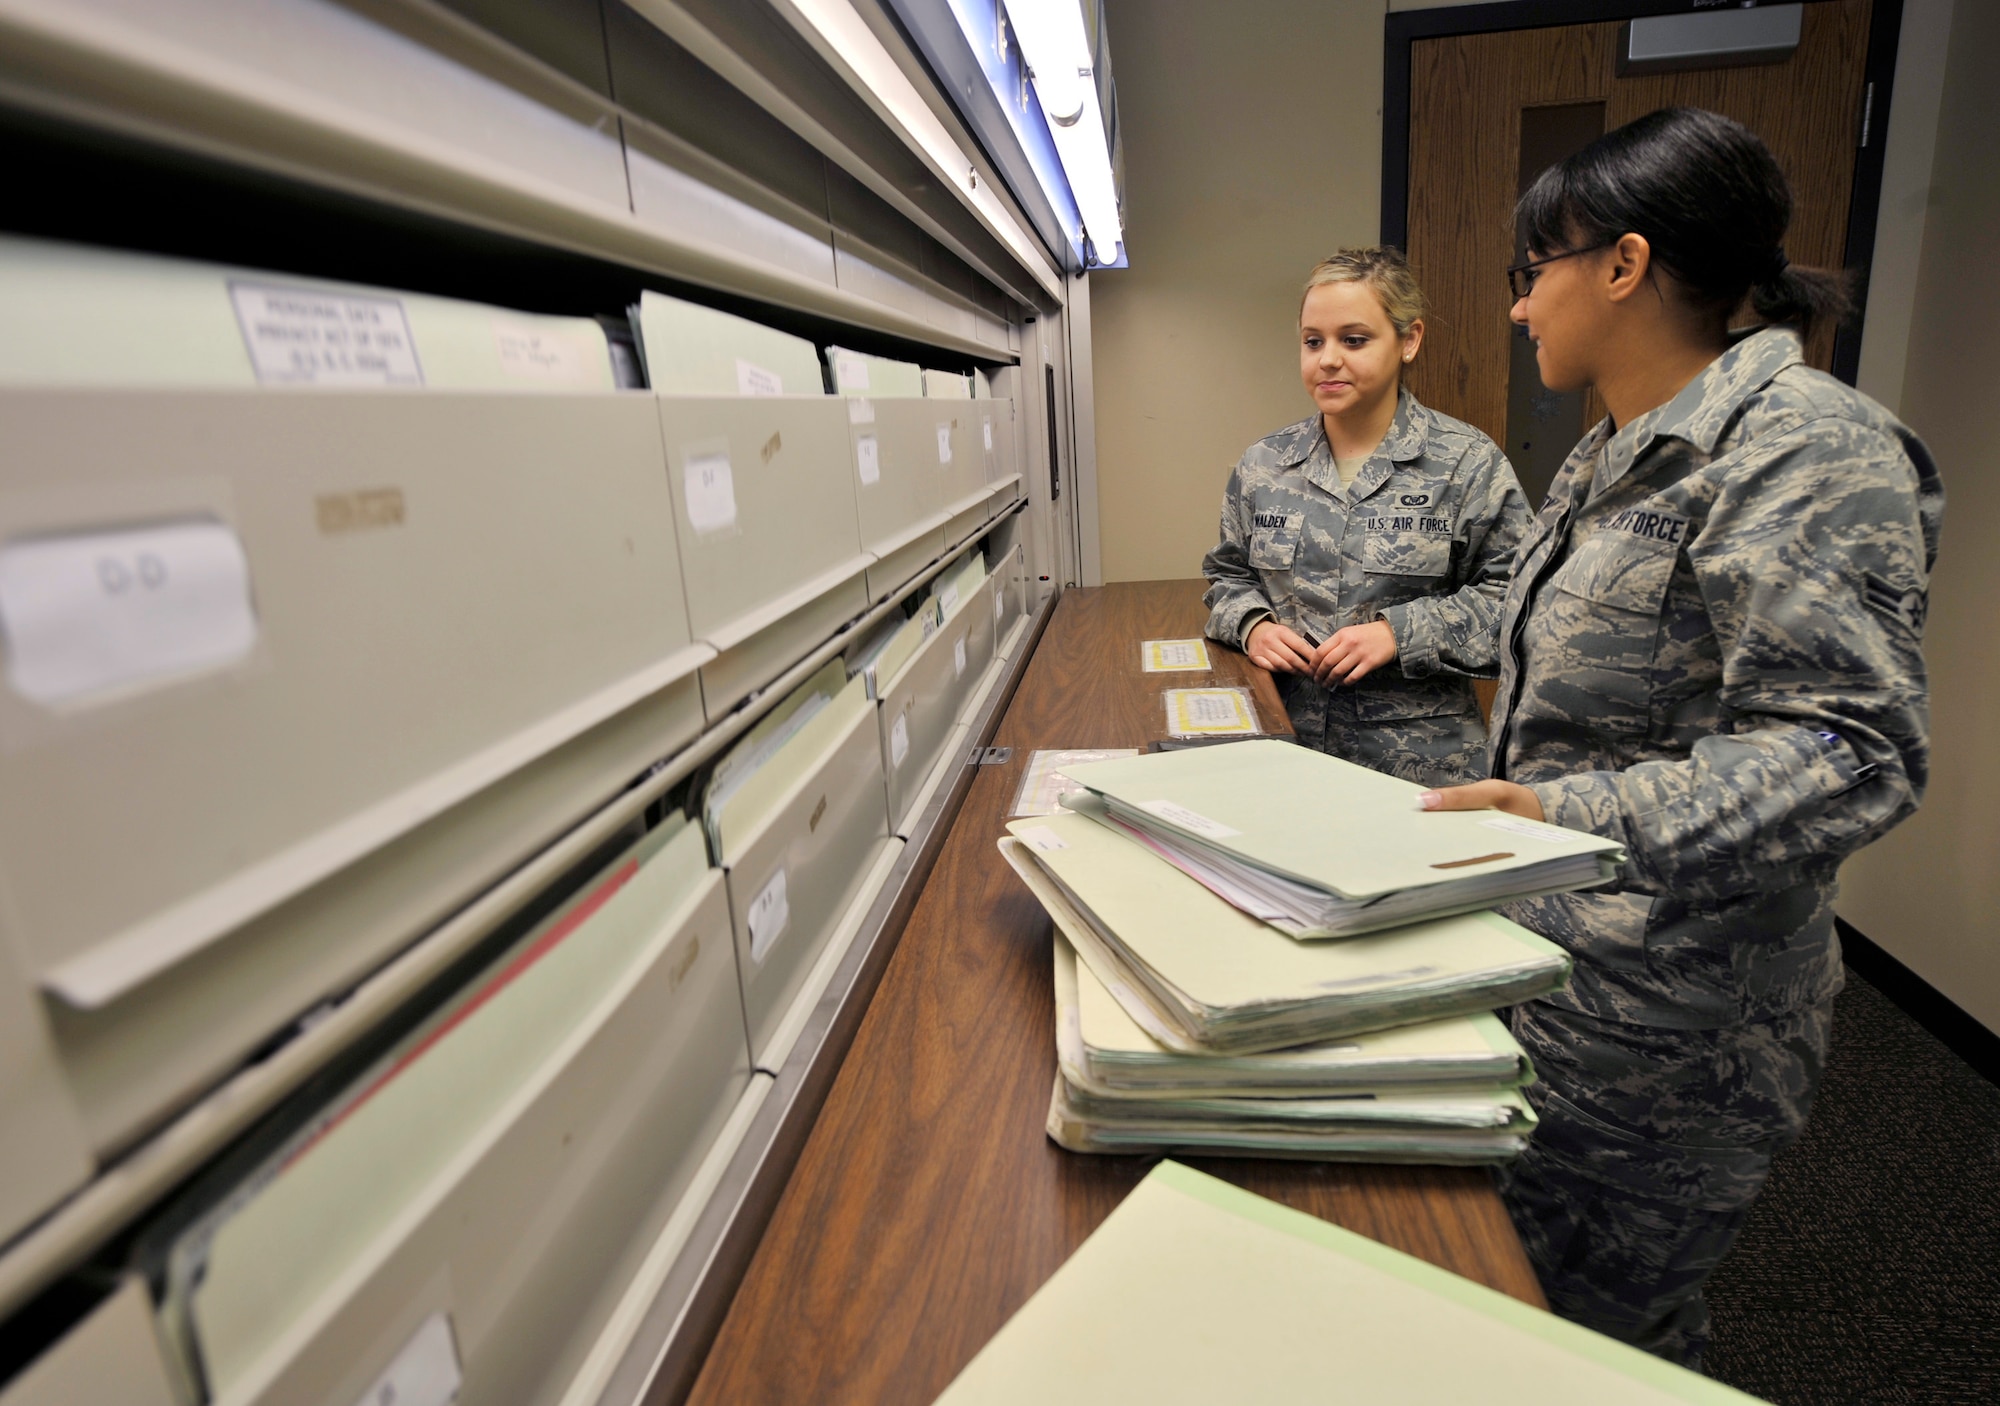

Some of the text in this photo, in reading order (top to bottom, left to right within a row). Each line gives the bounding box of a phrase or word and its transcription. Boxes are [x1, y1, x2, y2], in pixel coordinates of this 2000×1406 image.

[1254, 513, 1288, 529] WALDEN
[1368, 516, 1450, 532] U.S. AIR FORCE
[1624, 510, 1685, 543] FORCE
